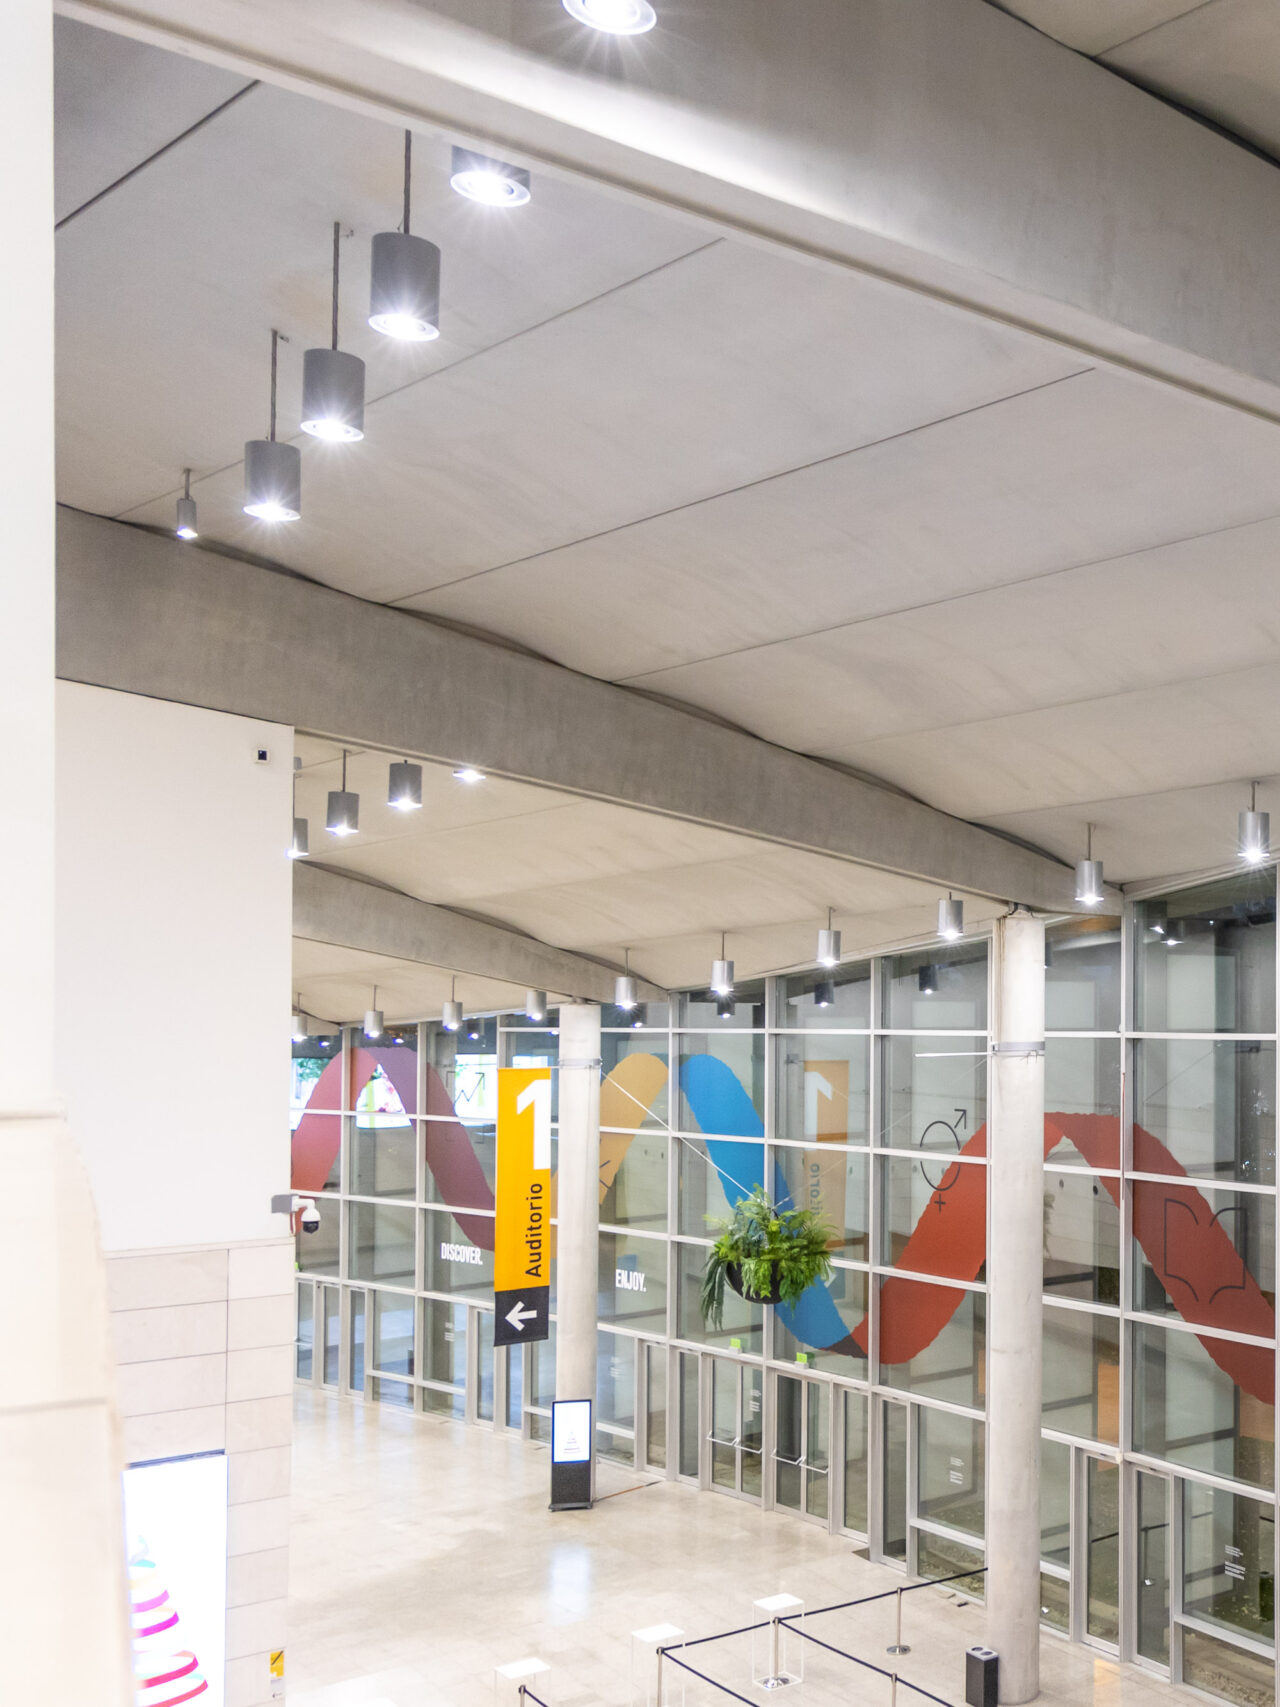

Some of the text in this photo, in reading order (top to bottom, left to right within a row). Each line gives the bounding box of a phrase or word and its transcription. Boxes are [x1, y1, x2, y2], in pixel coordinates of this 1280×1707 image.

[516, 1079, 551, 1170] 1
[441, 1242, 483, 1265] DISCOVER.
[525, 1183, 543, 1278] Auditorio
[615, 1269, 647, 1292] ENJOY.
